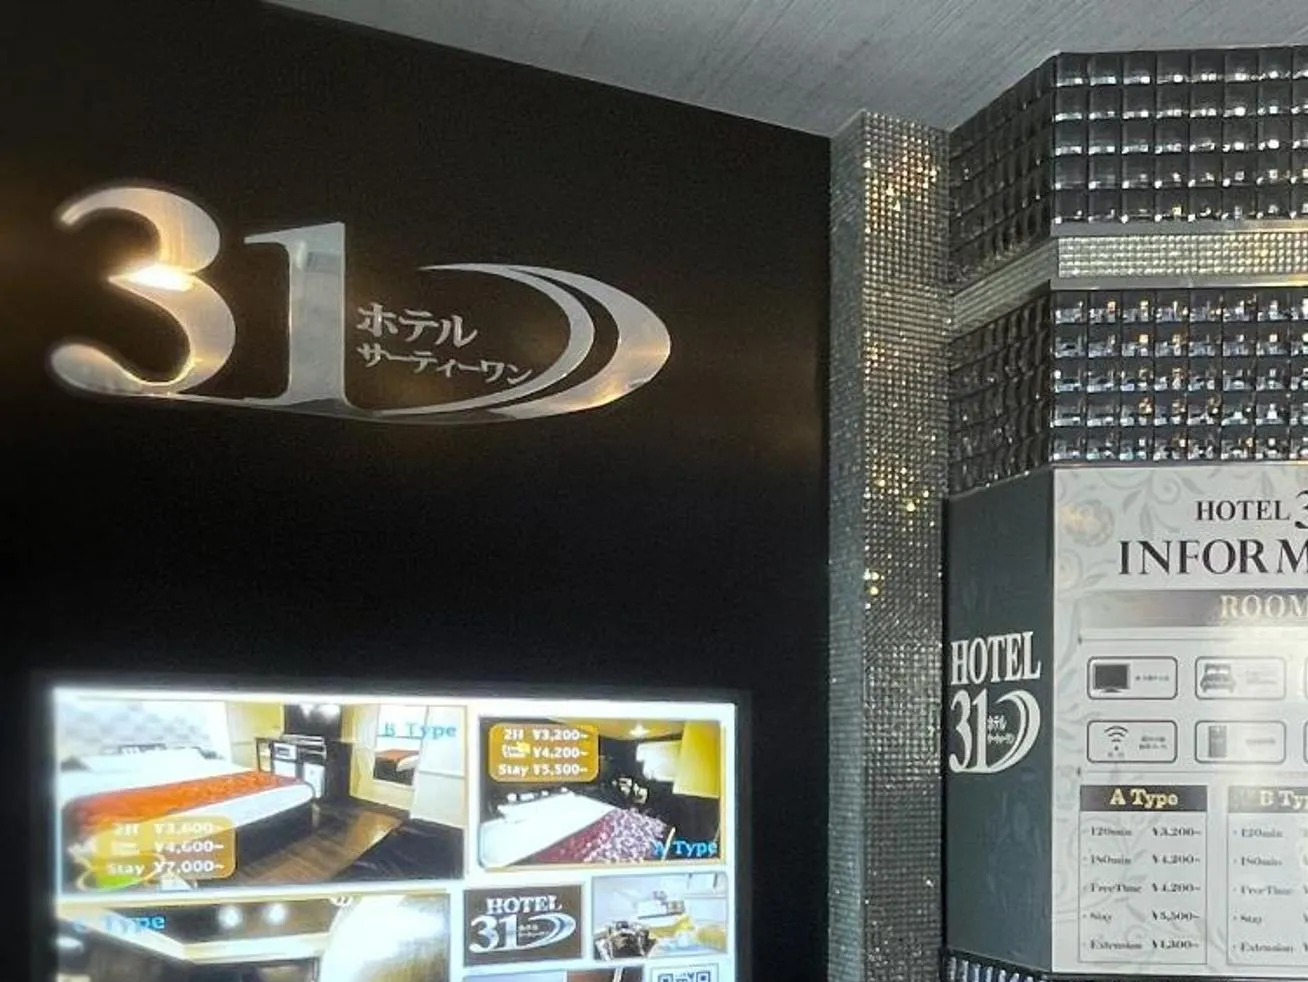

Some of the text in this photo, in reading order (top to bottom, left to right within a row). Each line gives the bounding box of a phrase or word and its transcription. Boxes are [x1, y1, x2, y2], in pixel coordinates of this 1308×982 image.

[50, 186, 347, 407] 31
[356, 302, 478, 348] ホテル
[356, 343, 533, 385] サーティーワン
[1196, 499, 1290, 521] HOTEL
[950, 631, 1042, 686] HOTEL
[405, 721, 458, 738] Type
[949, 687, 989, 773] 31
[498, 763, 529, 777] Stay
[1109, 788, 1178, 809] A Type
[677, 841, 718, 858] Type
[486, 894, 563, 915] HOTEL
[468, 913, 519, 953] 31
